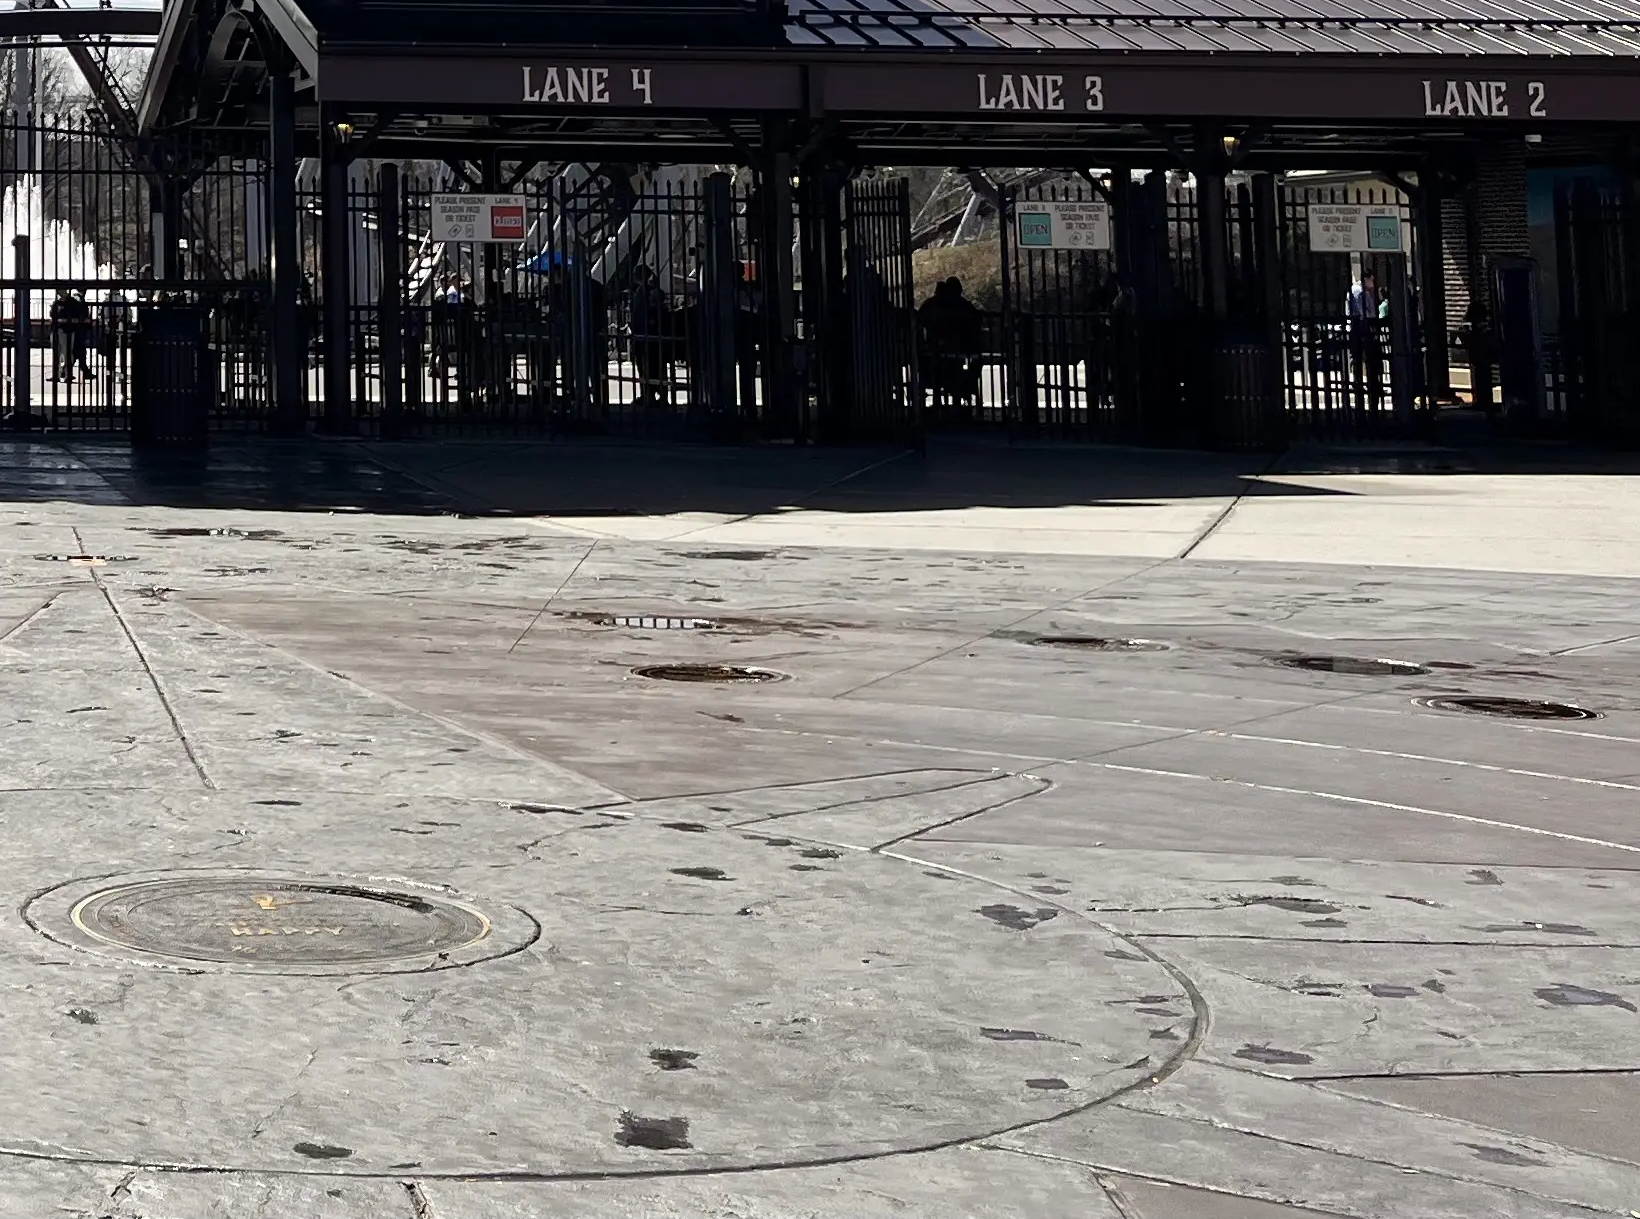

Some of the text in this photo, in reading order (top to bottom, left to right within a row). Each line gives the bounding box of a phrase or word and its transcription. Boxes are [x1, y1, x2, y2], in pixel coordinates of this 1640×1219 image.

[521, 66, 653, 104] LANE 4
[977, 73, 1104, 111] LANE 3
[1422, 80, 1547, 117] LANE 2
[1023, 224, 1048, 235] OPEN
[1371, 227, 1395, 239] OPEN
